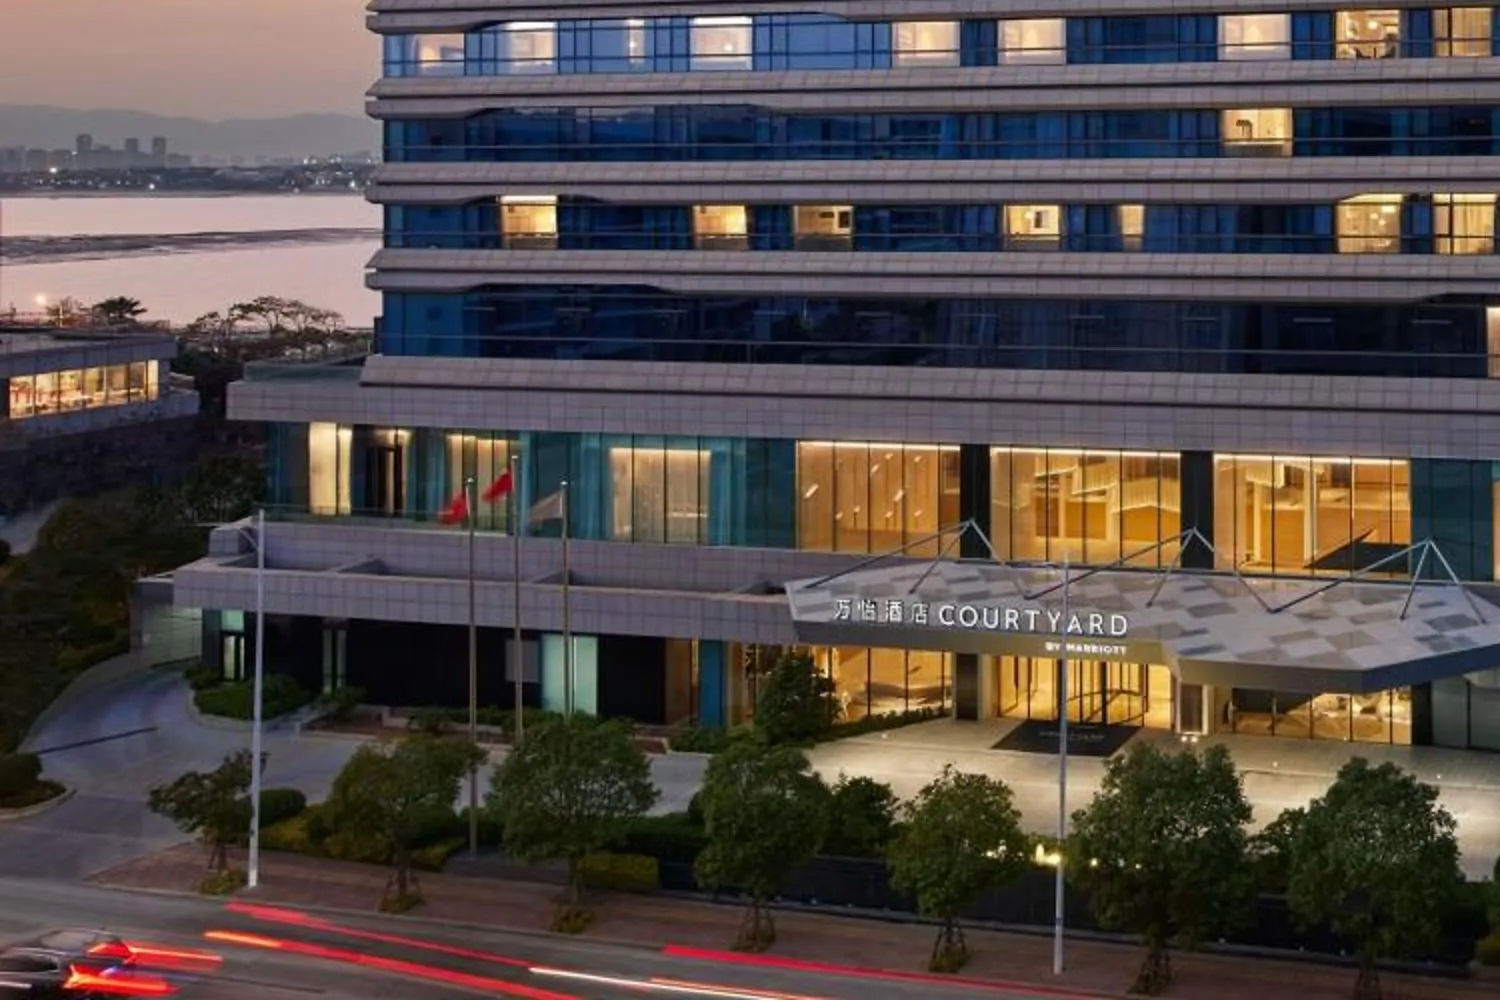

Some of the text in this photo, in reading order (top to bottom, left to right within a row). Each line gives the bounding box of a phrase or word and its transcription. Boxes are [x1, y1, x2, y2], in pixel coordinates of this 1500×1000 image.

[833, 599, 1128, 636] 万怡酒店 COURTYARD
[1065, 643, 1128, 656] MARRIOTT
